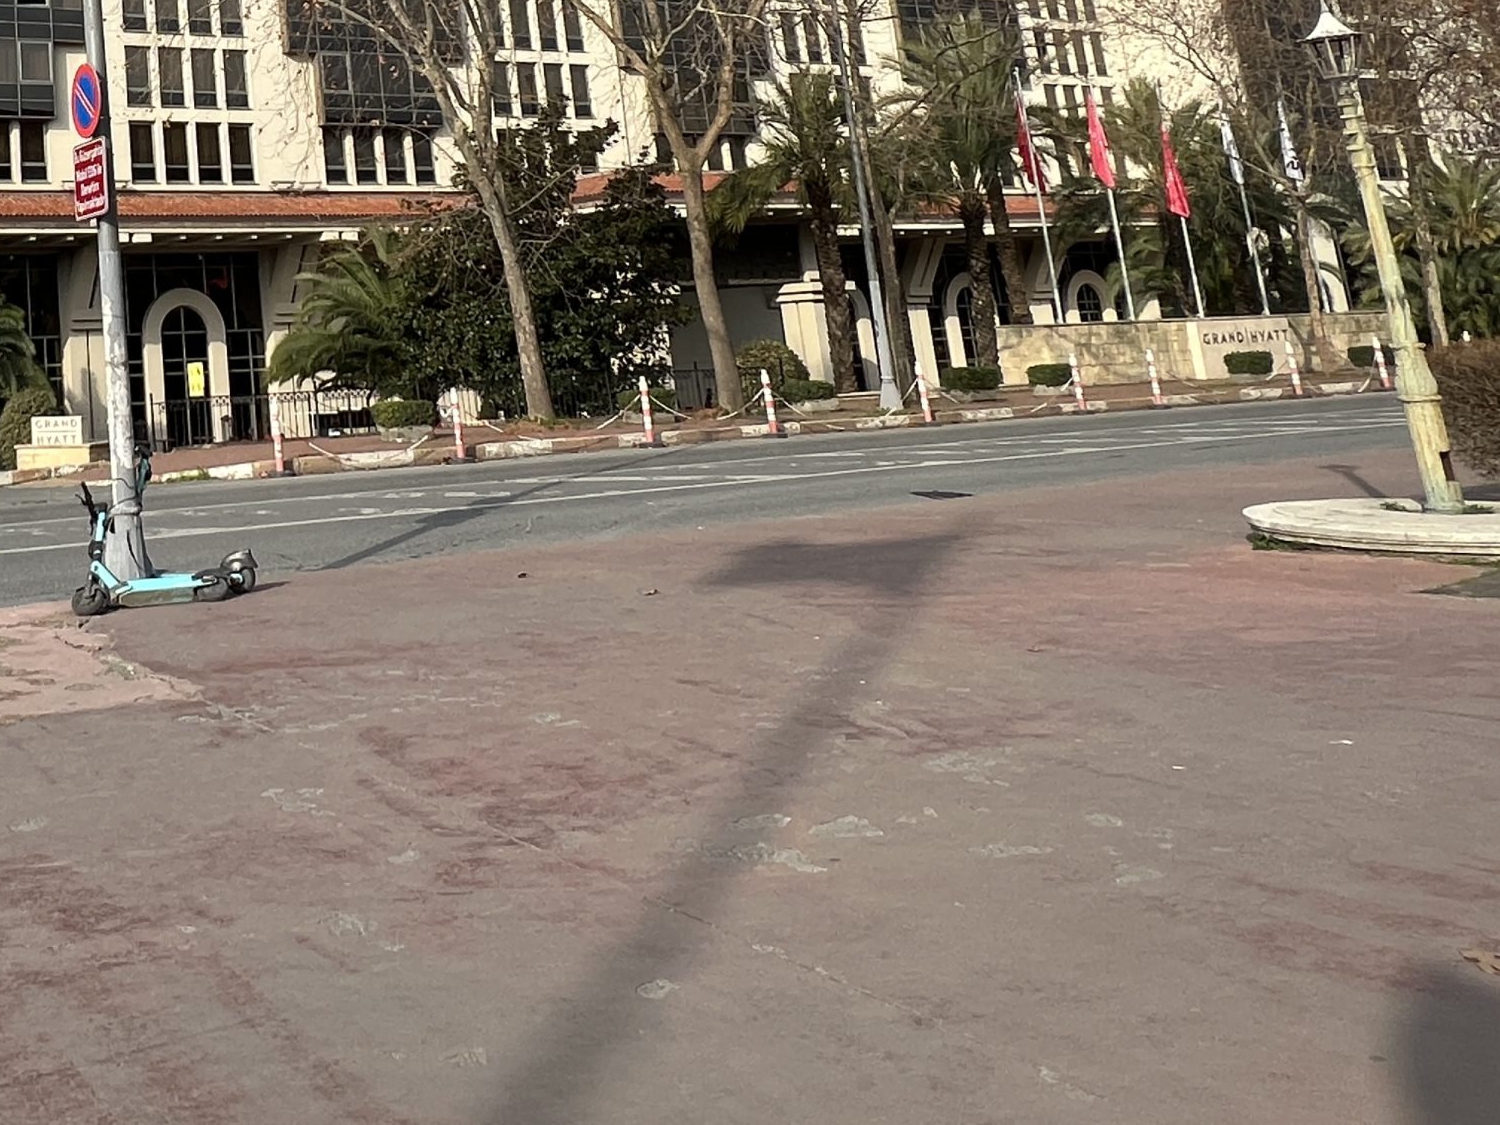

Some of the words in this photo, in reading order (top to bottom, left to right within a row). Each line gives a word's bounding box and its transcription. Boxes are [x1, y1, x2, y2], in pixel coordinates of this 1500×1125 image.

[1203, 331, 1244, 345] GRAND
[1250, 329, 1288, 343] HYATT
[35, 419, 77, 428] GRAND
[37, 435, 77, 444] HYATT
